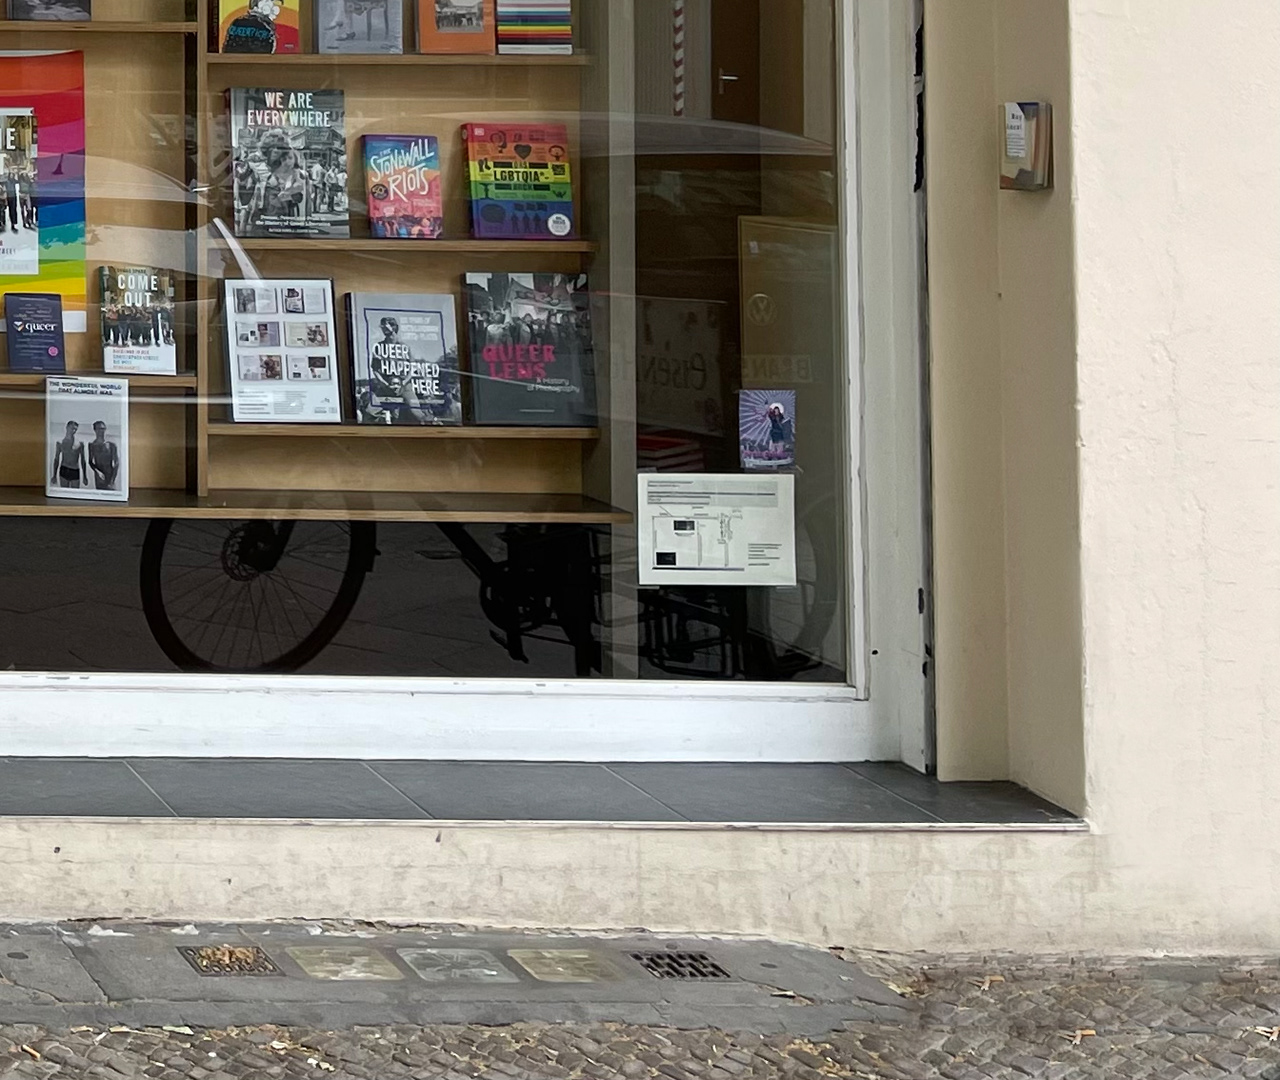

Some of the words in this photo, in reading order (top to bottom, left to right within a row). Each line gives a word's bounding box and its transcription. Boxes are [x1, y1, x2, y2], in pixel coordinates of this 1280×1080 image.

[264, 91, 284, 108] WE
[288, 92, 313, 109] ARE
[247, 110, 331, 127] EVERYWHERE
[370, 139, 434, 182] STONEWALL
[388, 163, 428, 202] RIOTS
[118, 274, 158, 290] COME
[124, 291, 152, 307] OUT
[25, 321, 58, 332] queer
[372, 343, 410, 359] QUEER
[481, 343, 556, 362] QUEER
[381, 360, 440, 377] HAPPENED
[489, 362, 546, 379] LENS
[411, 379, 440, 394] HERE
